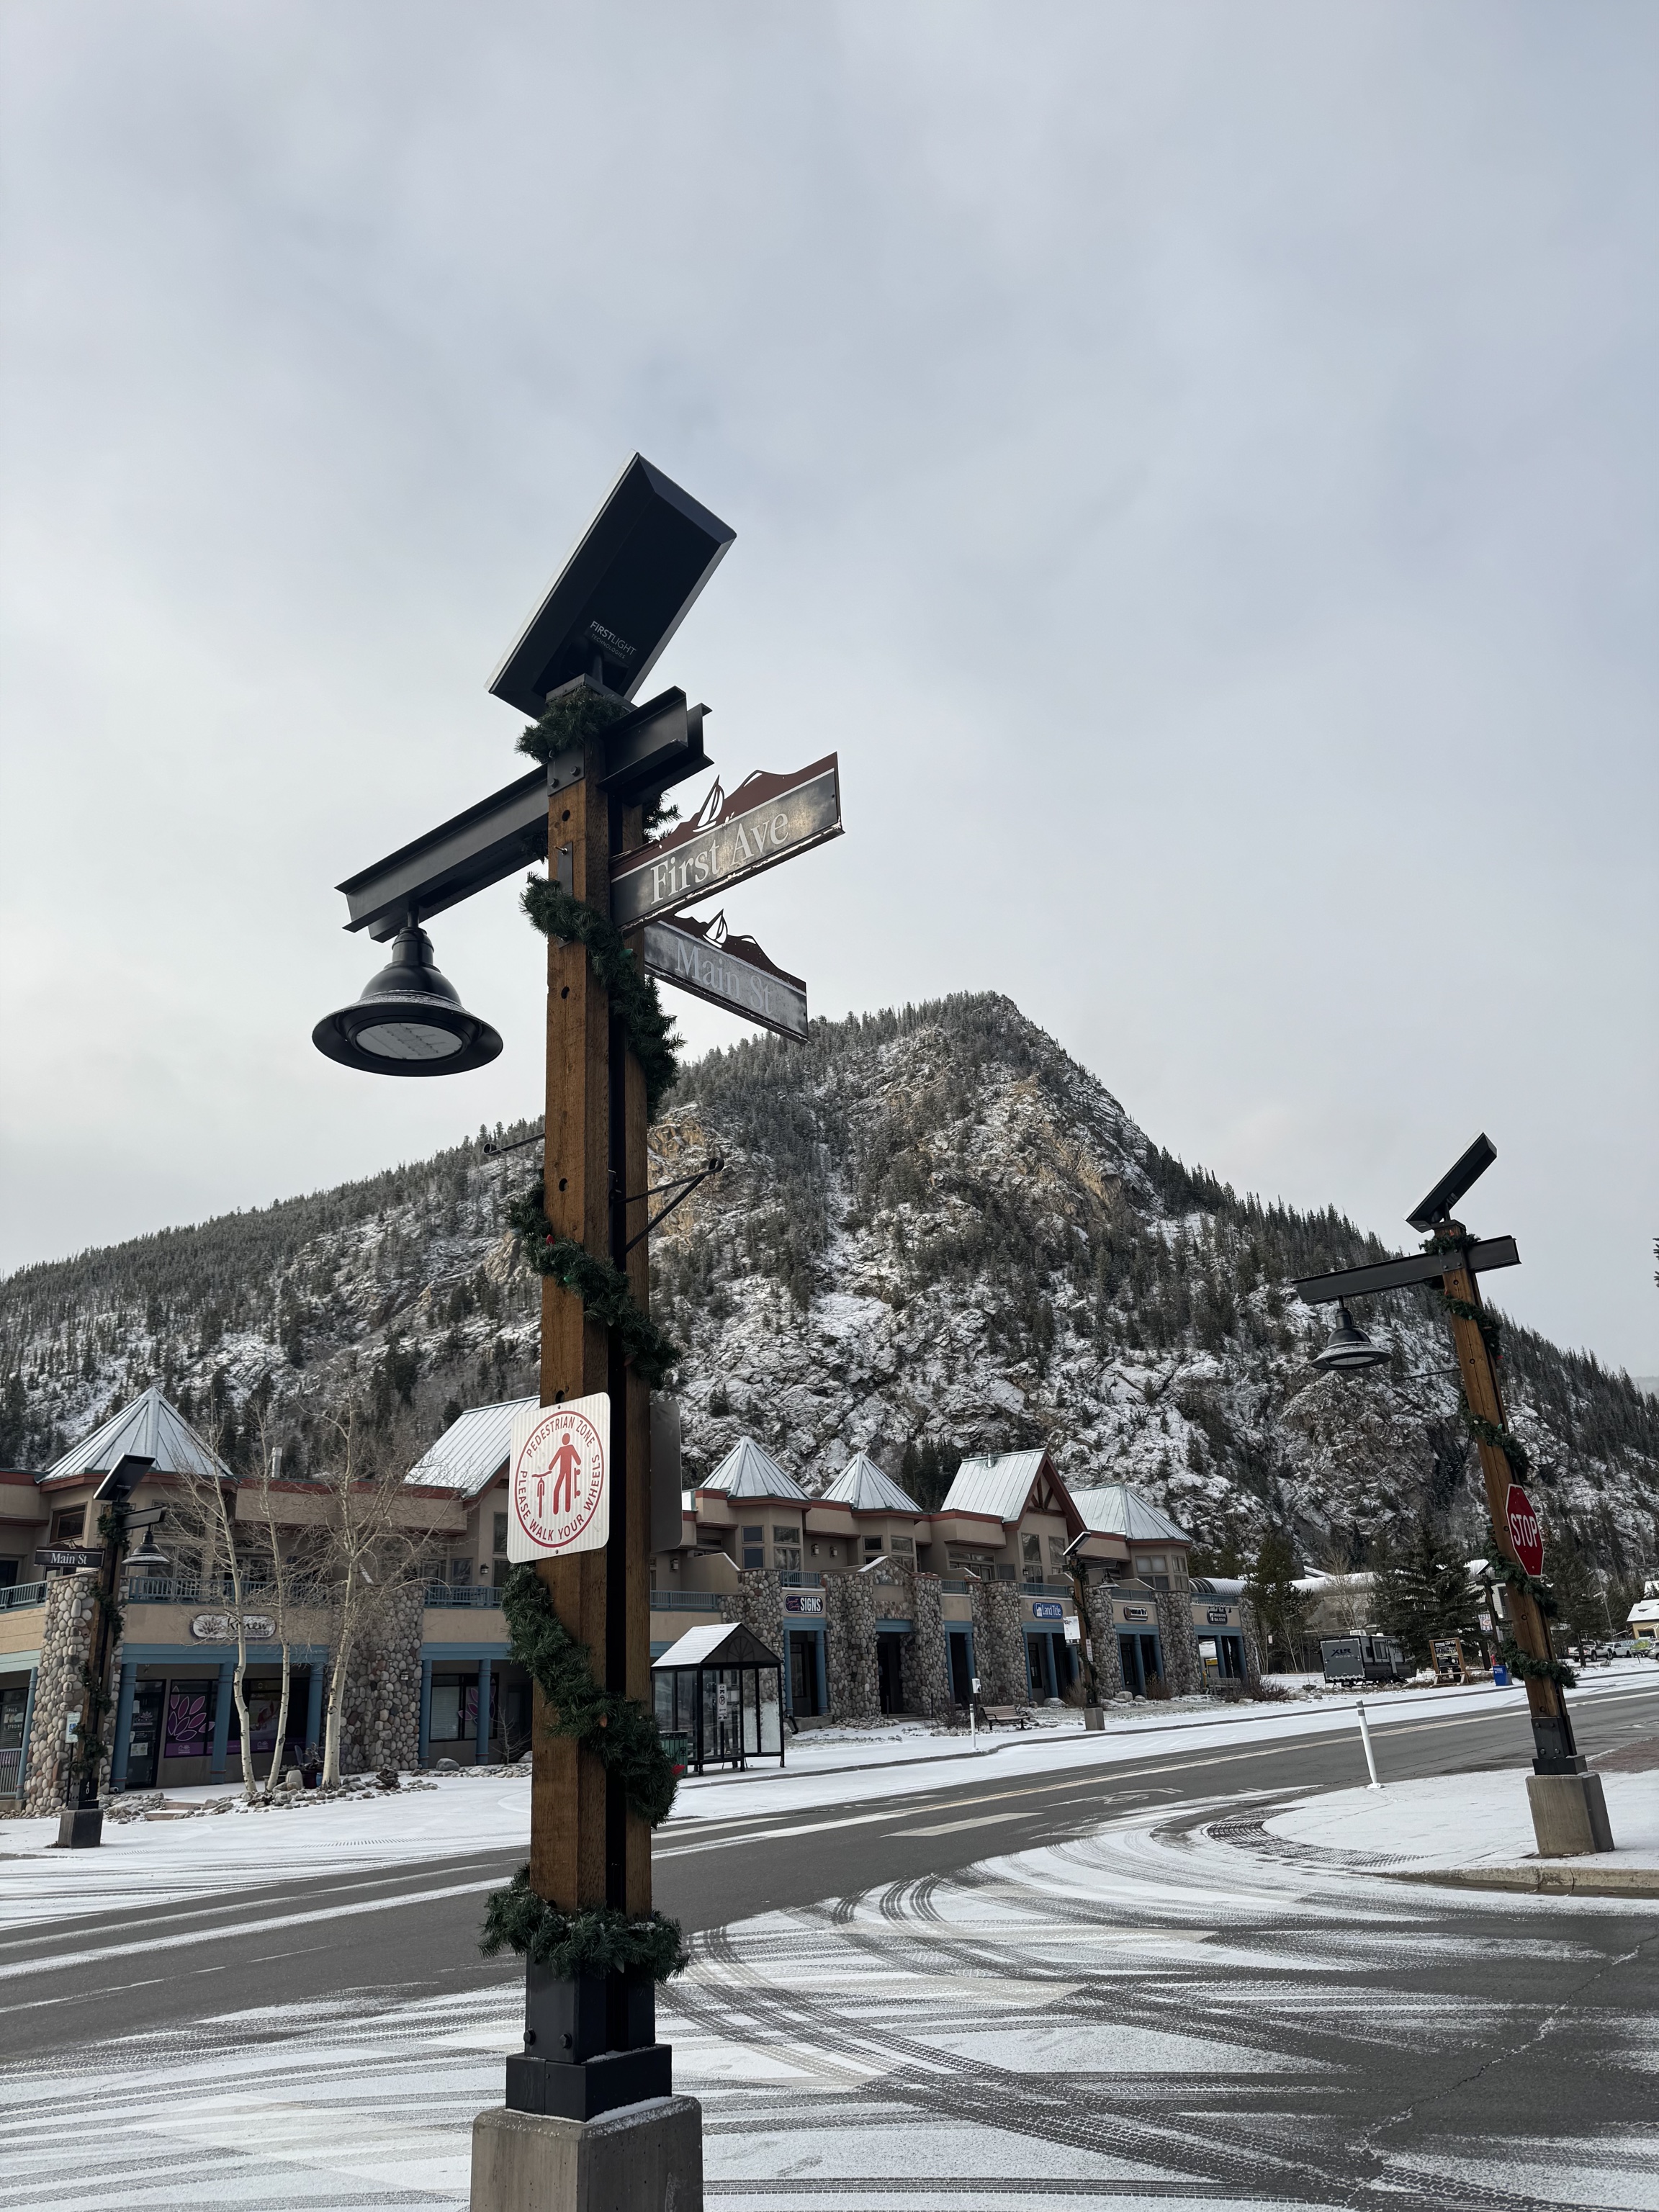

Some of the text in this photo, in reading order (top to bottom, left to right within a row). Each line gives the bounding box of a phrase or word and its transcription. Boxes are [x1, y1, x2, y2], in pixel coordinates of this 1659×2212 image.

[590, 621, 637, 655] FIRSTLIGHT
[591, 634, 626, 659] TECHNOLOGIES
[650, 813, 789, 904] First Ave
[675, 937, 772, 1015] Main St
[526, 1416, 595, 1458] PEDESTRIAN ZONE
[518, 1454, 601, 1542] PLEASE WALK YOUR WHEELS
[1511, 1513, 1537, 1547] STOP
[50, 1553, 87, 1565] Main St
[800, 1597, 821, 1611] SIGNS
[1042, 1604, 1061, 1615] Land Title
[1331, 1648, 1352, 1657] XLR
